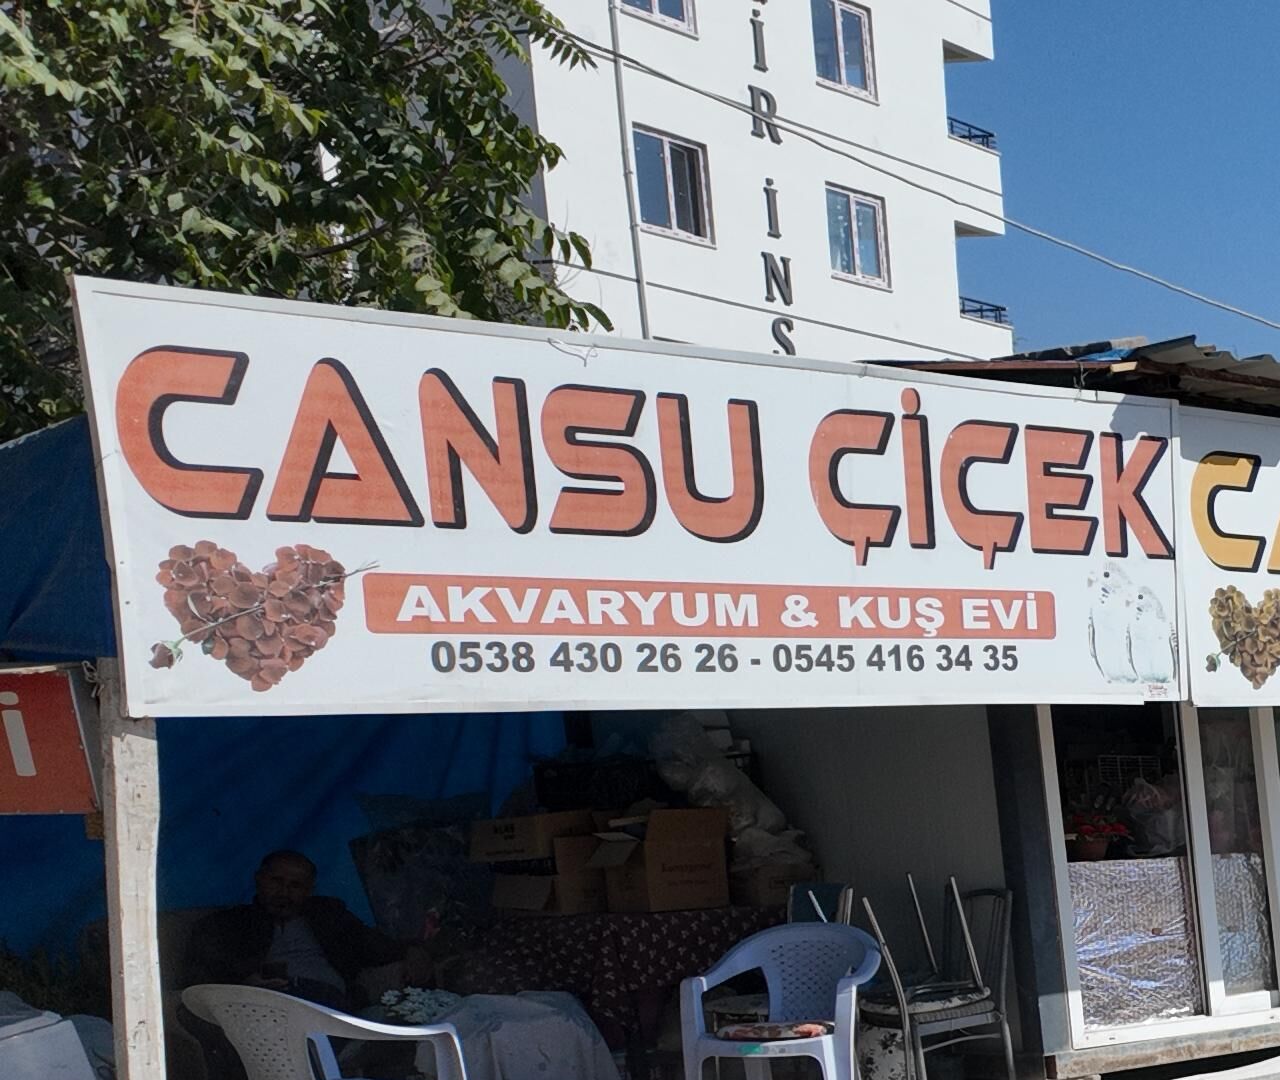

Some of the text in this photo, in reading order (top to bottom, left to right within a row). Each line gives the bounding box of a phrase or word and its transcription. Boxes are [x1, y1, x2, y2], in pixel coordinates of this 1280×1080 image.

[114, 345, 1175, 570] CANSU ÇİÇEK
[396, 585, 1038, 637] AKVARYUM & KUŞ EVİ
[431, 641, 536, 673] 0538
[549, 642, 623, 673] 430
[636, 643, 682, 673] 26
[694, 643, 739, 673] 26
[772, 644, 855, 673] 0545
[866, 644, 925, 673] 416
[935, 645, 973, 672] 34
[982, 645, 1018, 672] 35
